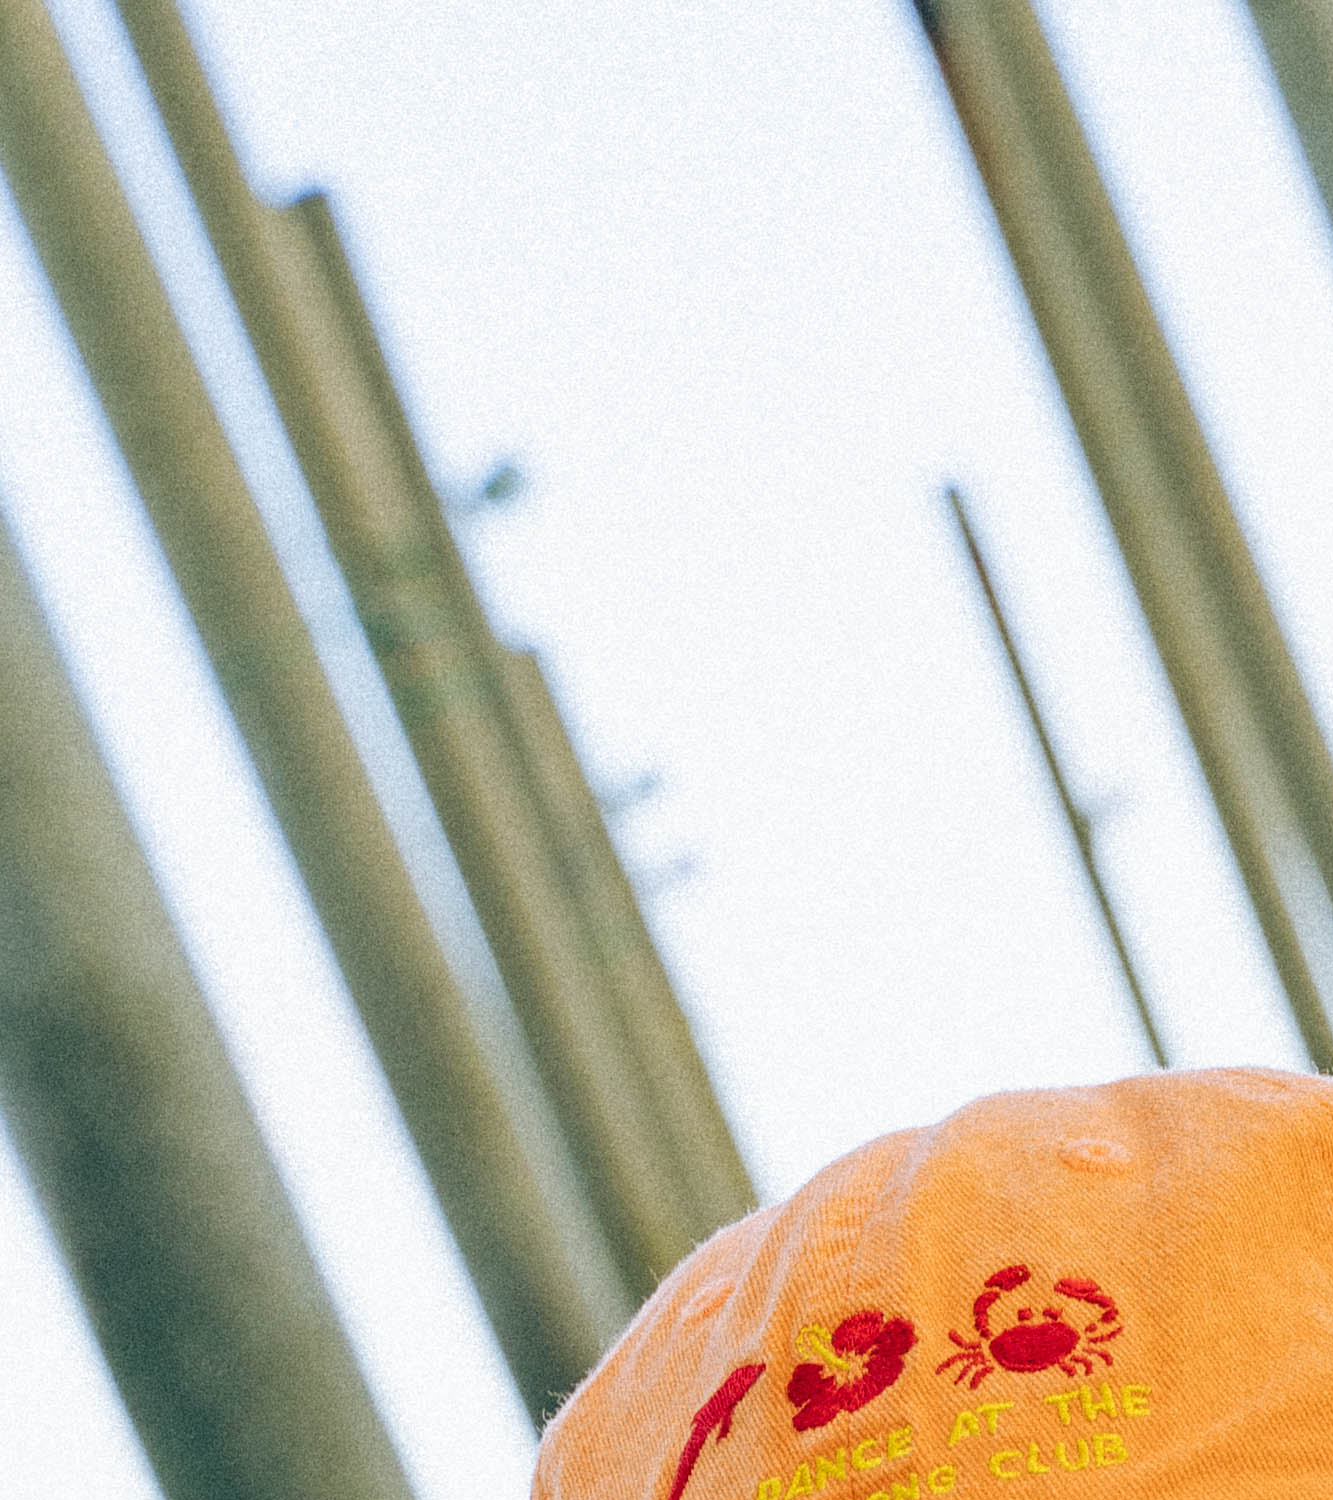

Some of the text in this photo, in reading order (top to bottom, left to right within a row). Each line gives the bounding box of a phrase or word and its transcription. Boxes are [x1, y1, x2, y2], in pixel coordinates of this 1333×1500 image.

[949, 1401, 1014, 1446] AT
[1044, 1383, 1151, 1424] THE
[988, 1433, 1128, 1479] CLUB
